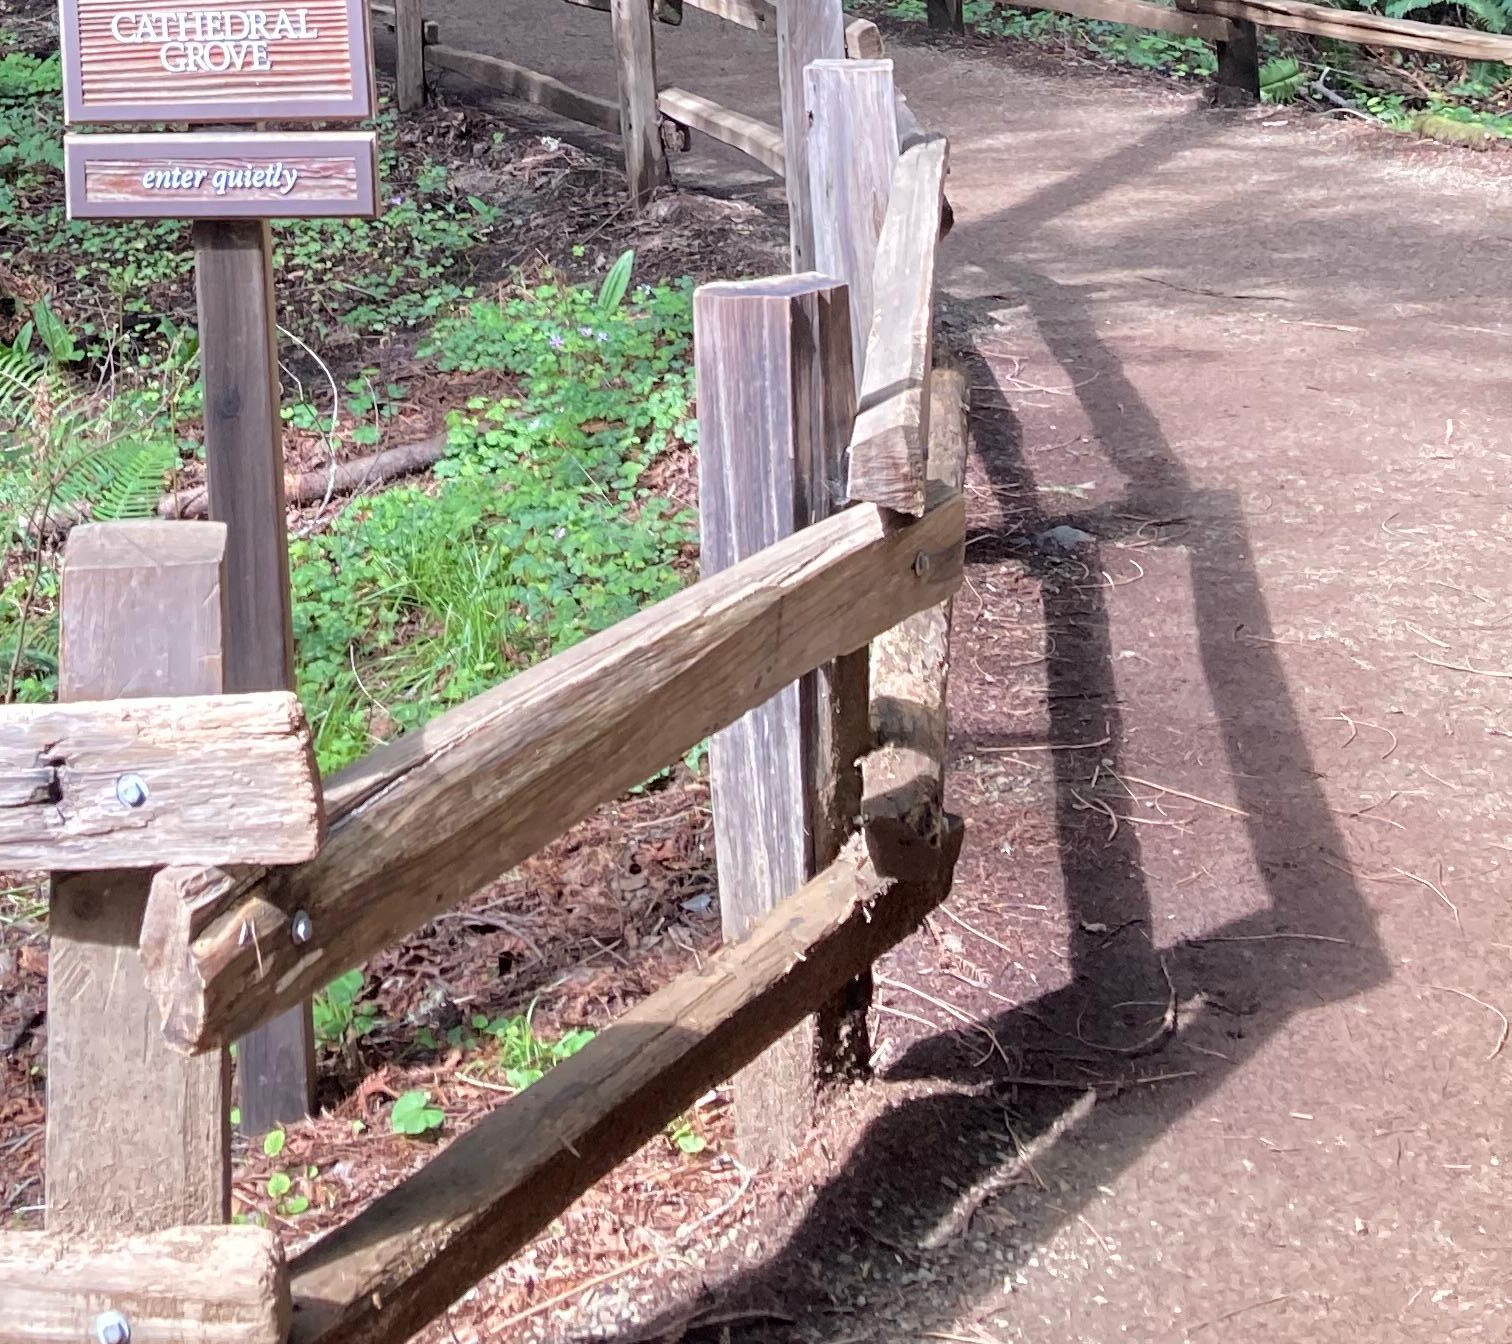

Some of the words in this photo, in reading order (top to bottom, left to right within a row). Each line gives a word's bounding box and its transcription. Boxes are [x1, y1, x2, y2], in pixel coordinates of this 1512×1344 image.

[111, 9, 317, 43] CATHEDRAL
[160, 42, 272, 72] GROVE
[142, 168, 207, 189] enter
[212, 163, 298, 195] quietly
